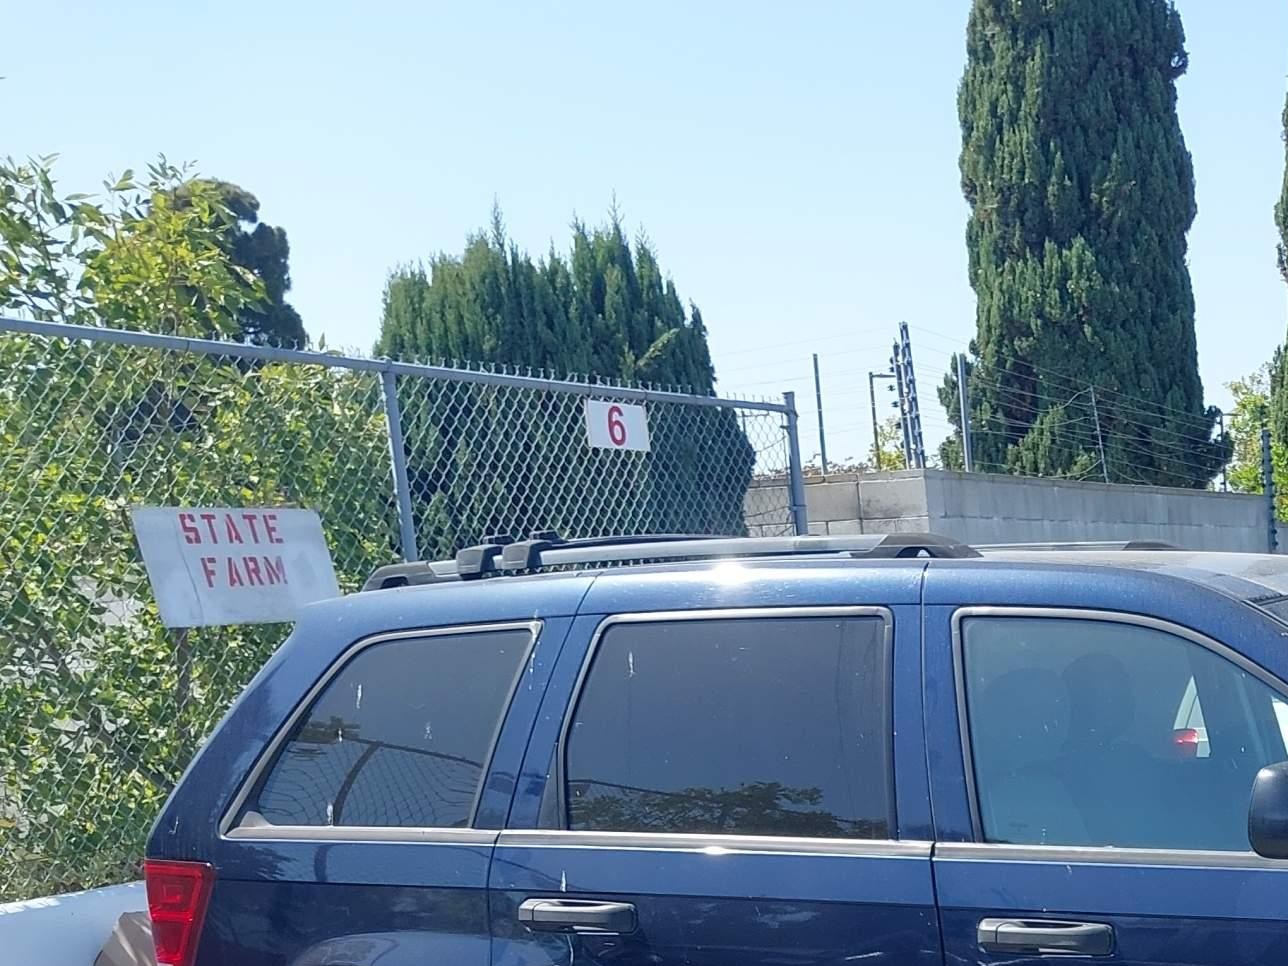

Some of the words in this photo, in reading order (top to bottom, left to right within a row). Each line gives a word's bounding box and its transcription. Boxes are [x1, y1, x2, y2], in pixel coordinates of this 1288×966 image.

[608, 405, 626, 447] 6
[178, 513, 284, 545] STATE
[201, 555, 288, 588] FARM
